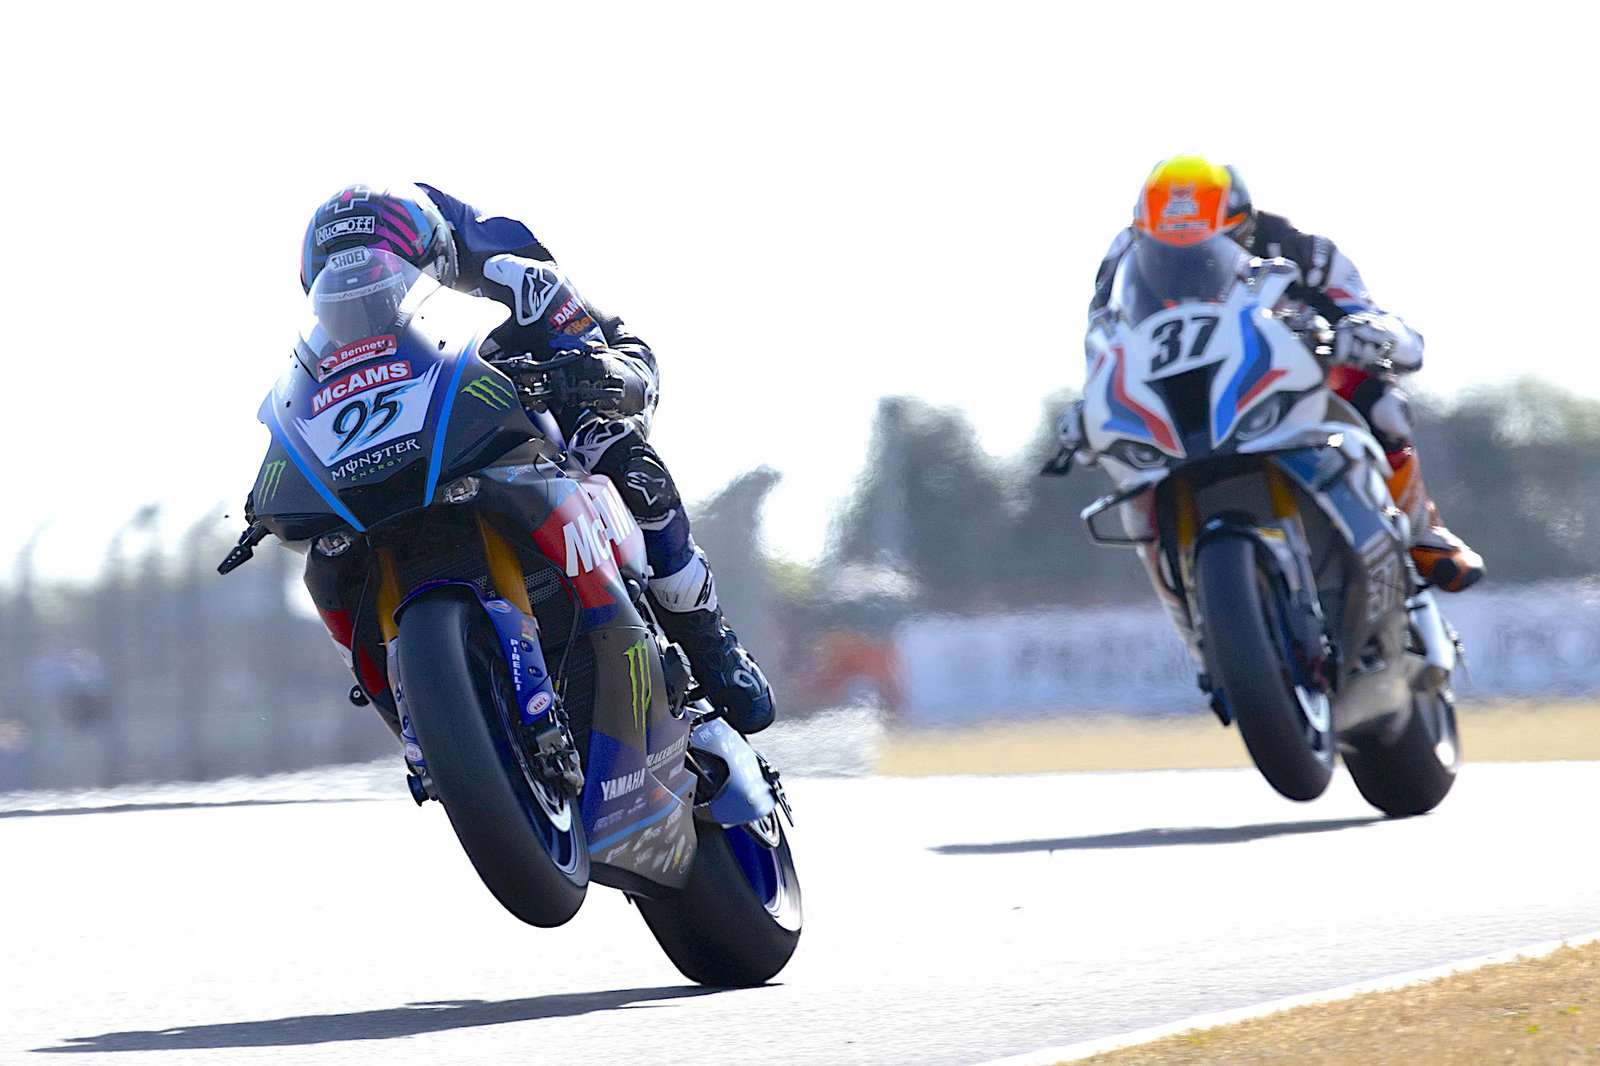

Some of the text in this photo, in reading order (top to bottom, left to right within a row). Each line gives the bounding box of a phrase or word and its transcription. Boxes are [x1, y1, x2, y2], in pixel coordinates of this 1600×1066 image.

[331, 250, 366, 269] SHOEI
[1150, 315, 1221, 373] 37
[313, 362, 410, 414] McAMS
[333, 384, 408, 455] 95
[331, 437, 421, 482] MONSTER
[350, 457, 404, 482] ENERGY
[510, 638, 523, 691] PIRELLI
[600, 768, 646, 802] YAMAHA
